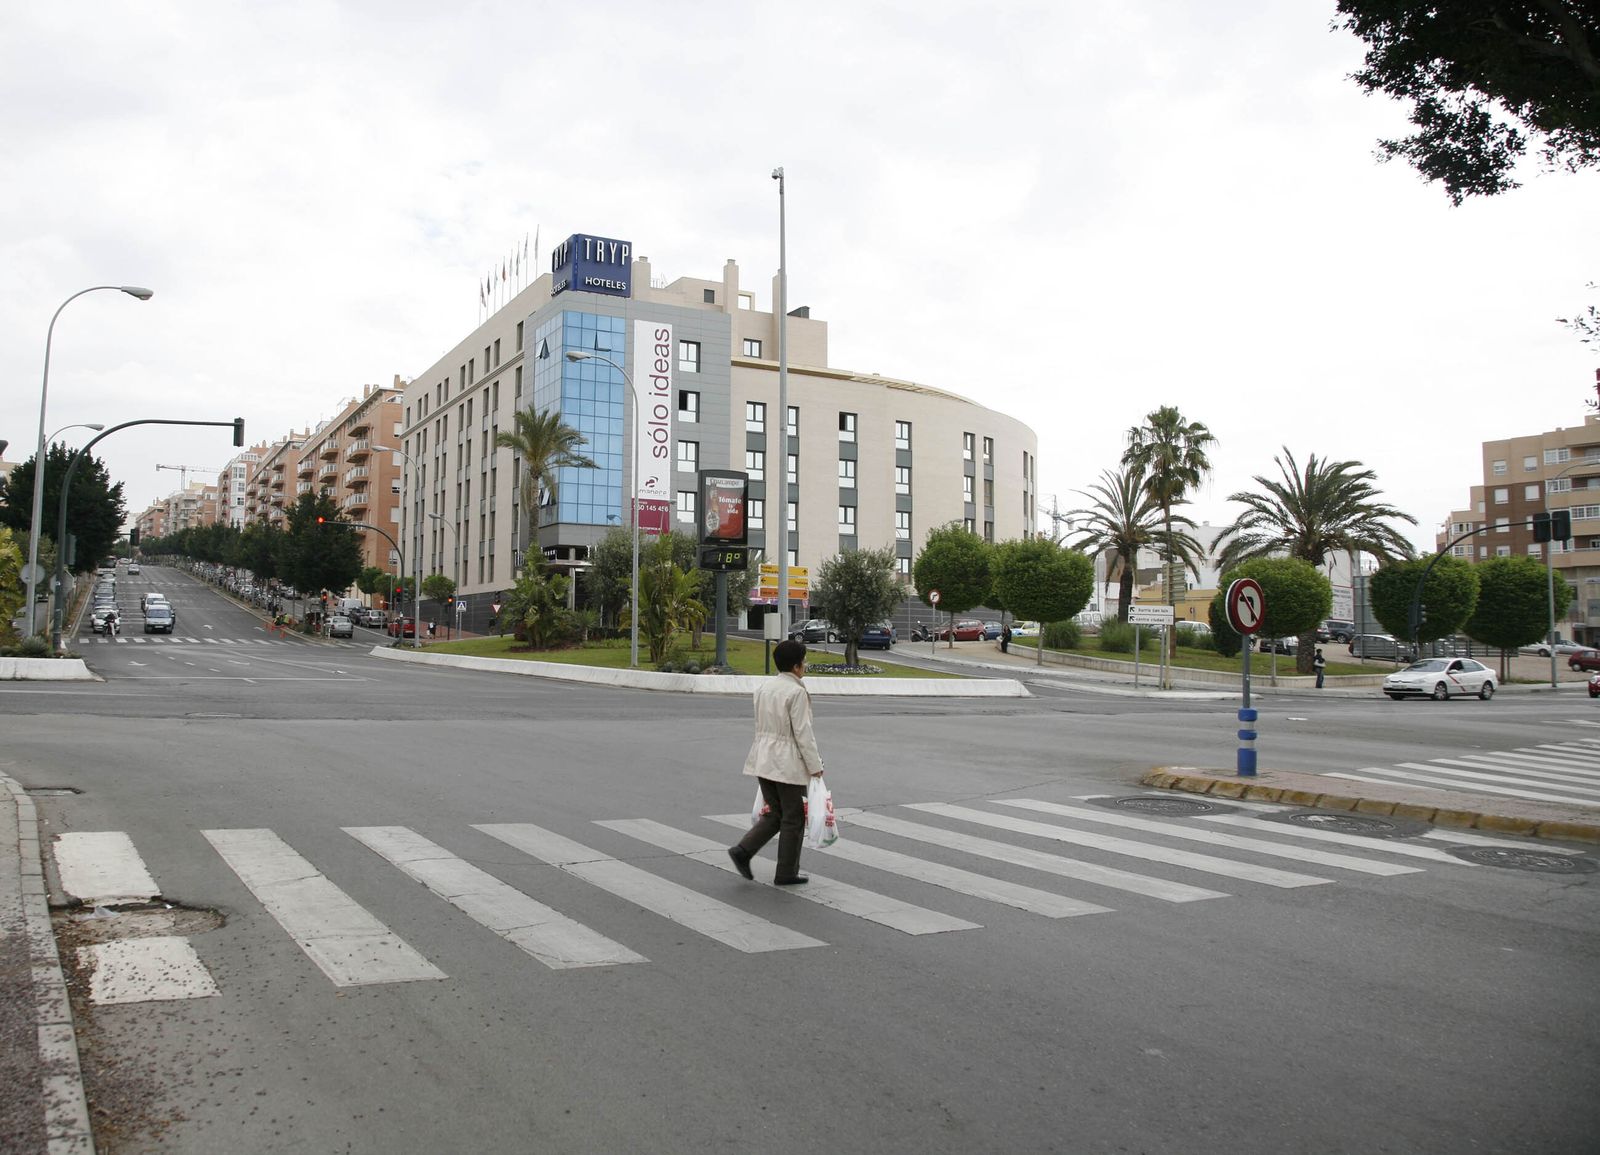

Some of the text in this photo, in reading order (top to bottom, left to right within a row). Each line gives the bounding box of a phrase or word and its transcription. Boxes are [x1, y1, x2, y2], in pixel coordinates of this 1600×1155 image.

[585, 238, 629, 266] TRYP
[585, 276, 627, 290] HOTELES
[647, 328, 670, 459] sólo ideas
[718, 496, 742, 504] Tómate
